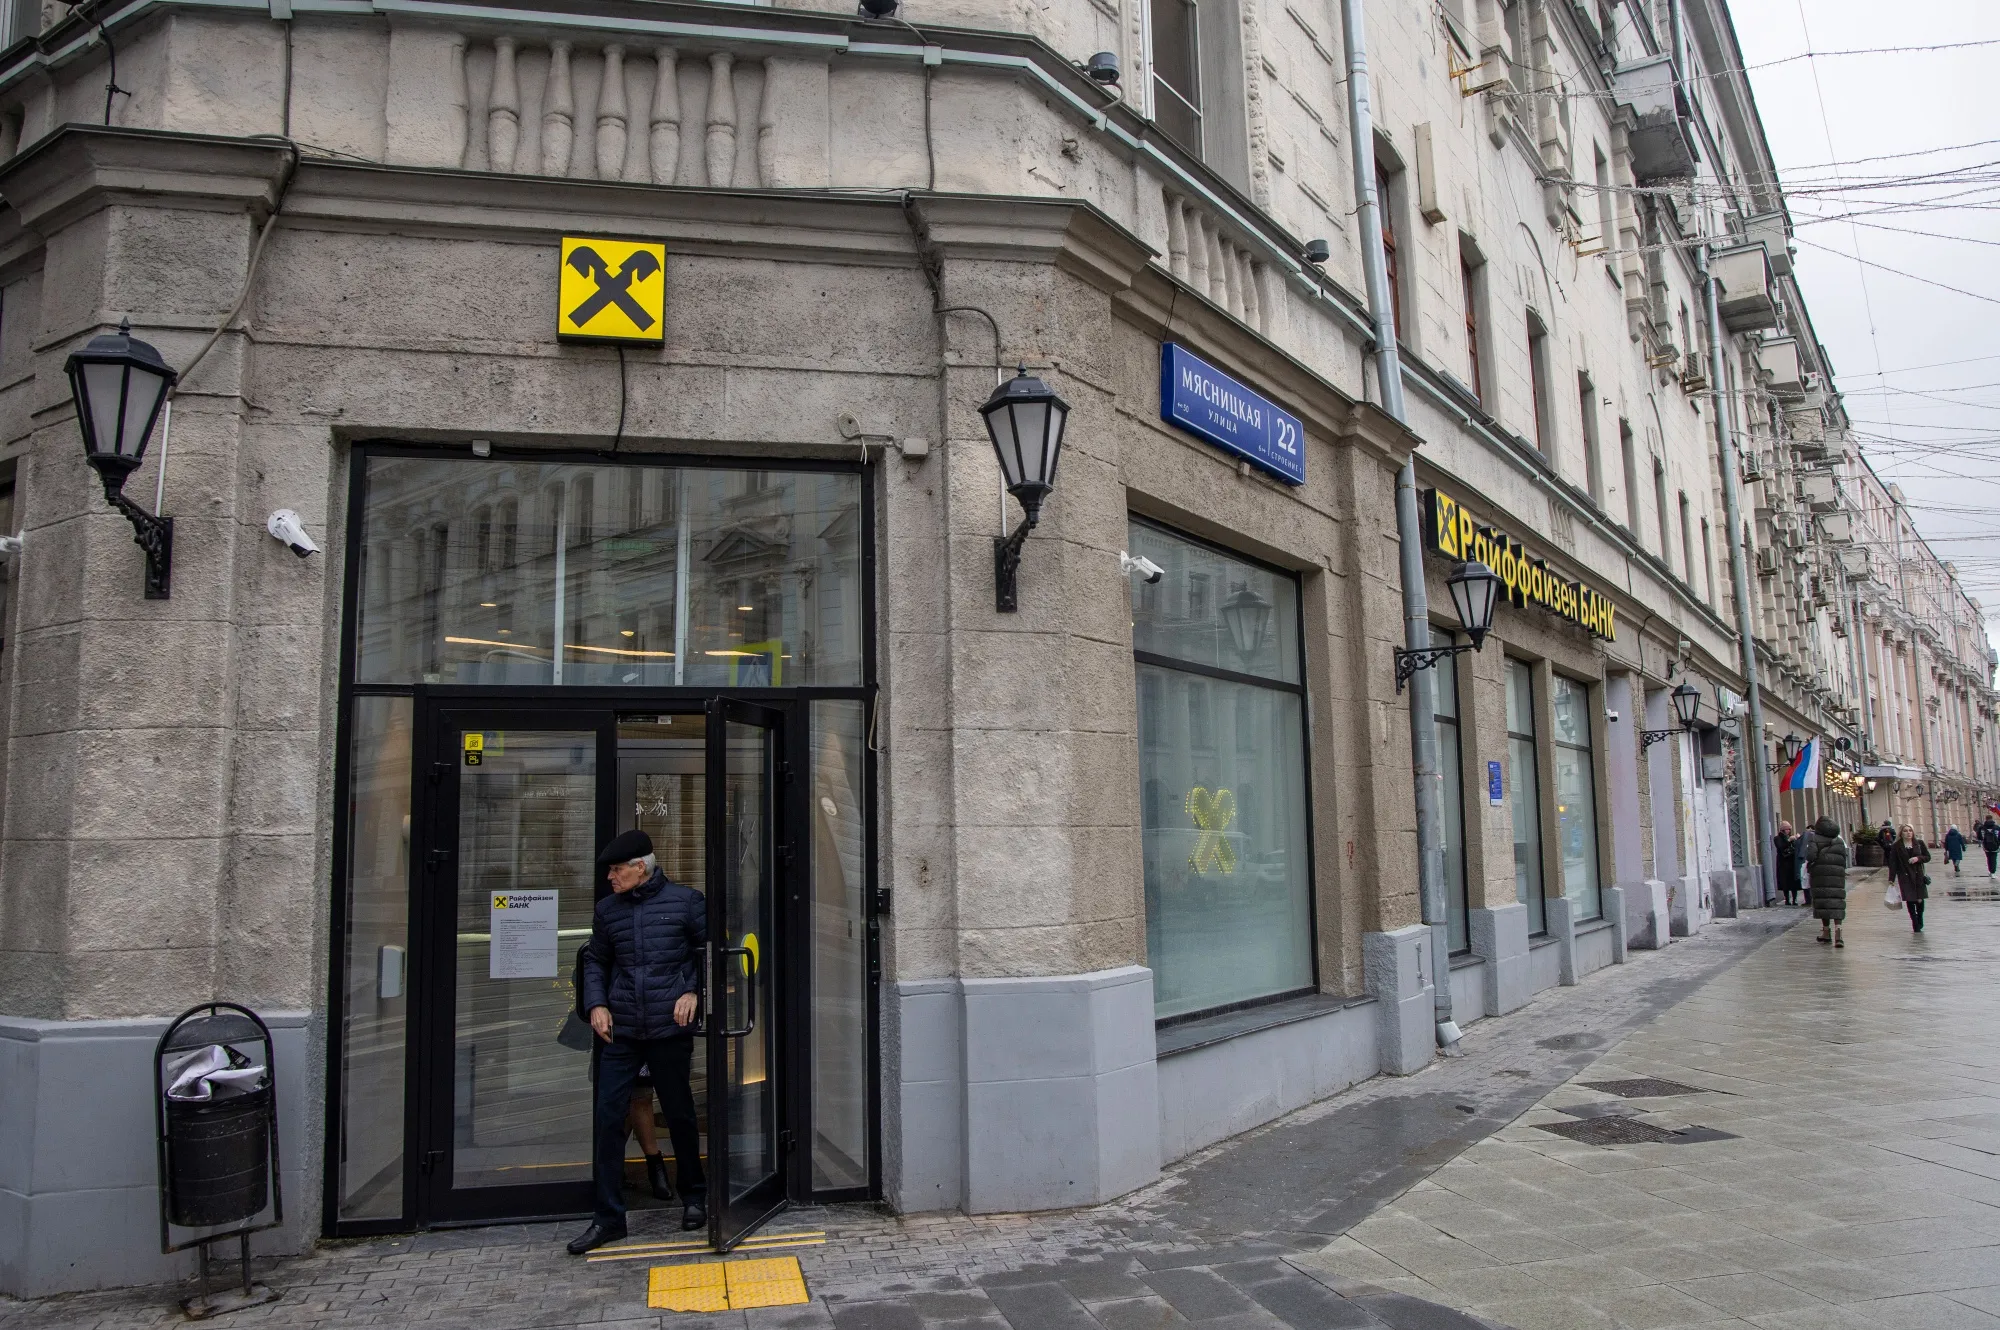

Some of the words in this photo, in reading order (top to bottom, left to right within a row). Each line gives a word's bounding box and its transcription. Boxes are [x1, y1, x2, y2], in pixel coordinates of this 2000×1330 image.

[1182, 366, 1261, 430] МЯСНИЦКАЯ
[1208, 409, 1238, 434] УЛИЦА
[1277, 417, 1296, 456] 22
[1271, 452, 1298, 471] СТРОЕНИЕ
[1459, 506, 1579, 621] Райффайзен
[1580, 583, 1616, 641] БАНК
